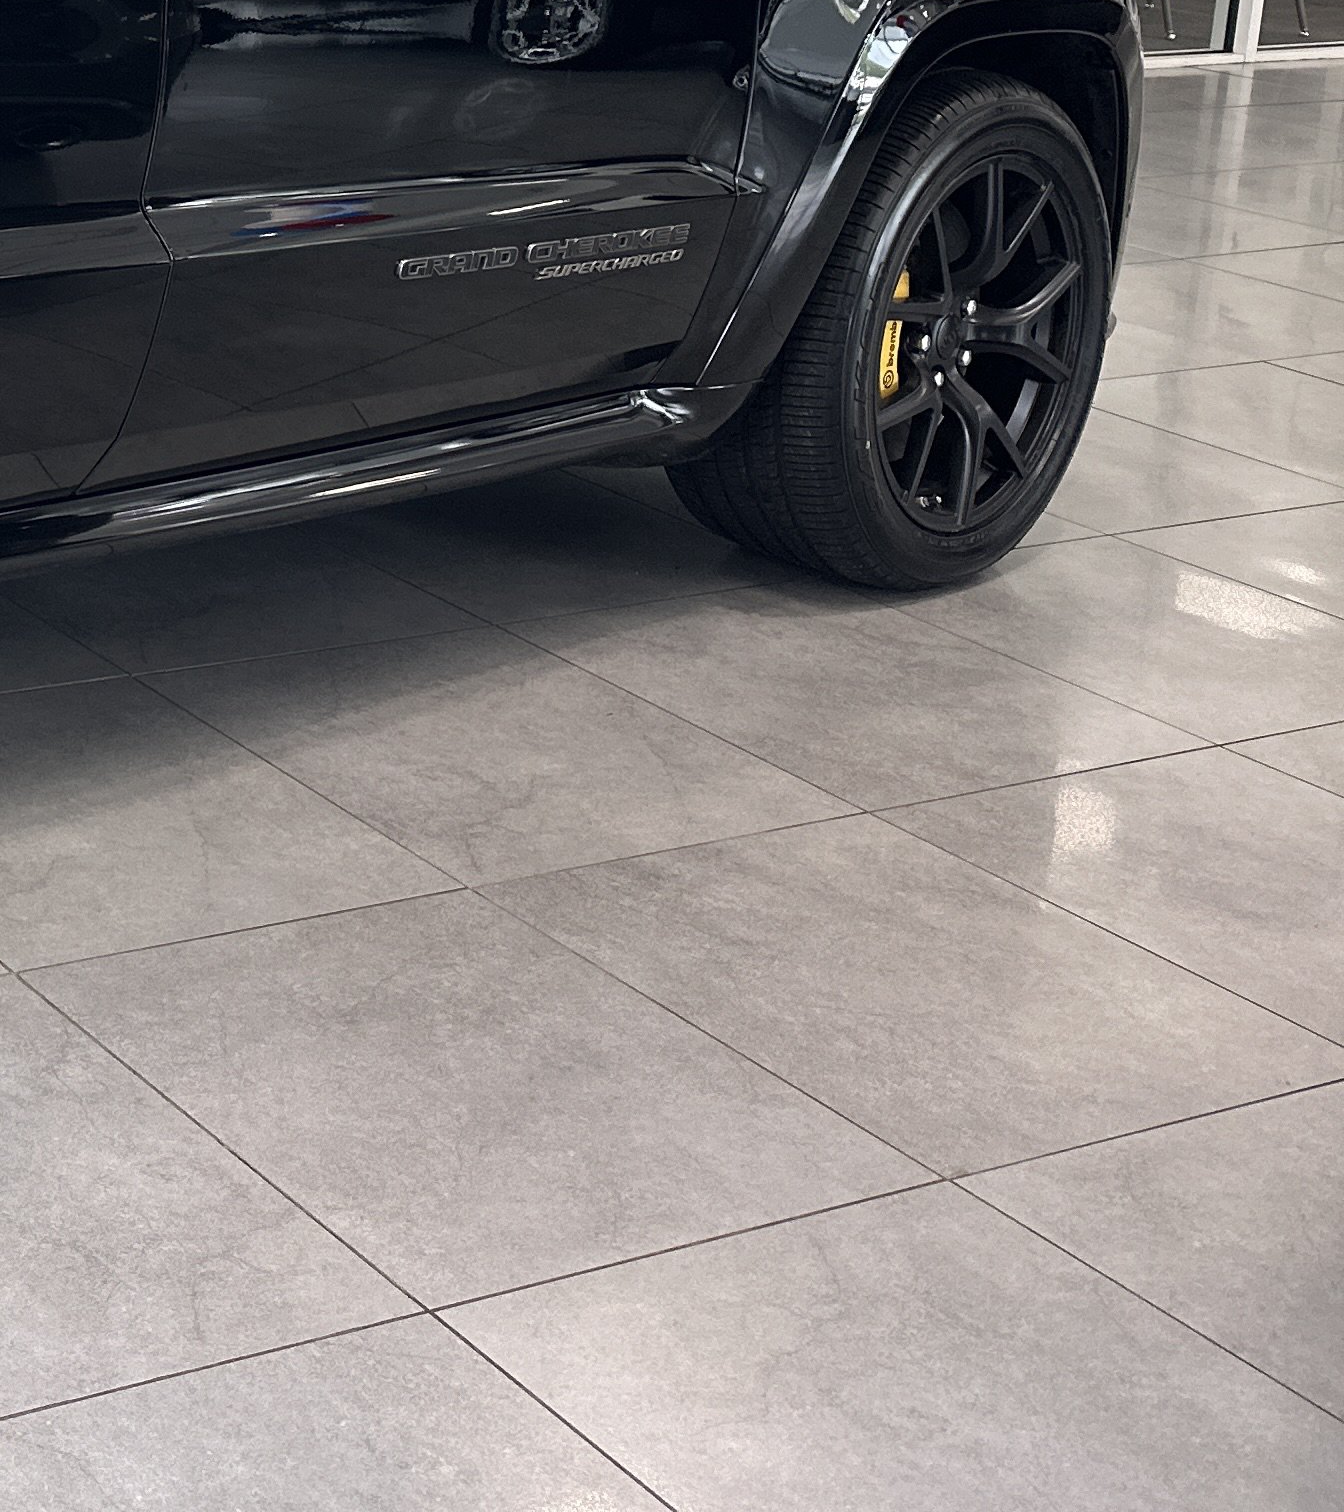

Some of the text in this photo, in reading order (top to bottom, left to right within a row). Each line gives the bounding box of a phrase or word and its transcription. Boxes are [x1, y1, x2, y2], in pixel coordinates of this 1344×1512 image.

[397, 223, 691, 280] GRAND CHEROKEE
[535, 248, 685, 281] SUPERCHARGED
